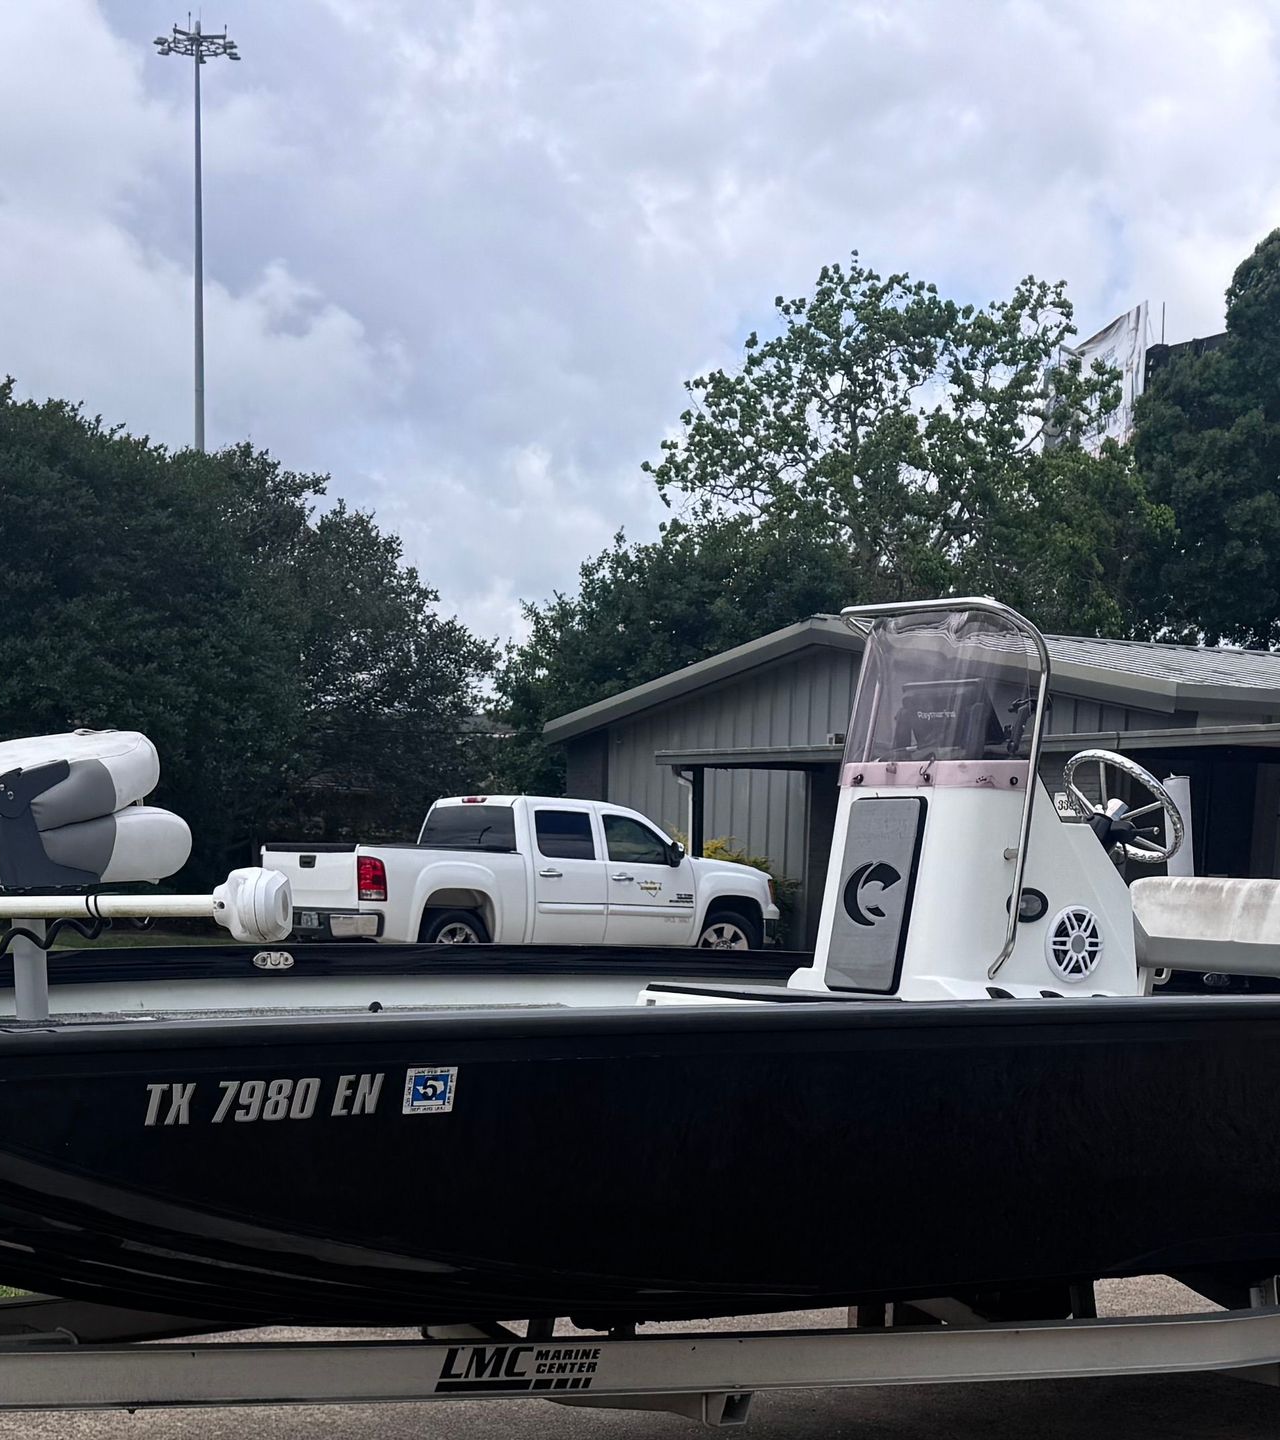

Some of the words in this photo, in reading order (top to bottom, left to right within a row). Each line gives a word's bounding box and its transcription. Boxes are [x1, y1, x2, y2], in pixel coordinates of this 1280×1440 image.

[144, 1082, 197, 1126] TX
[211, 1078, 321, 1124] 7980
[331, 1073, 385, 1117] EN
[439, 1346, 535, 1379] LMC
[535, 1348, 602, 1361] MARINE
[535, 1361, 599, 1374] CENTER
